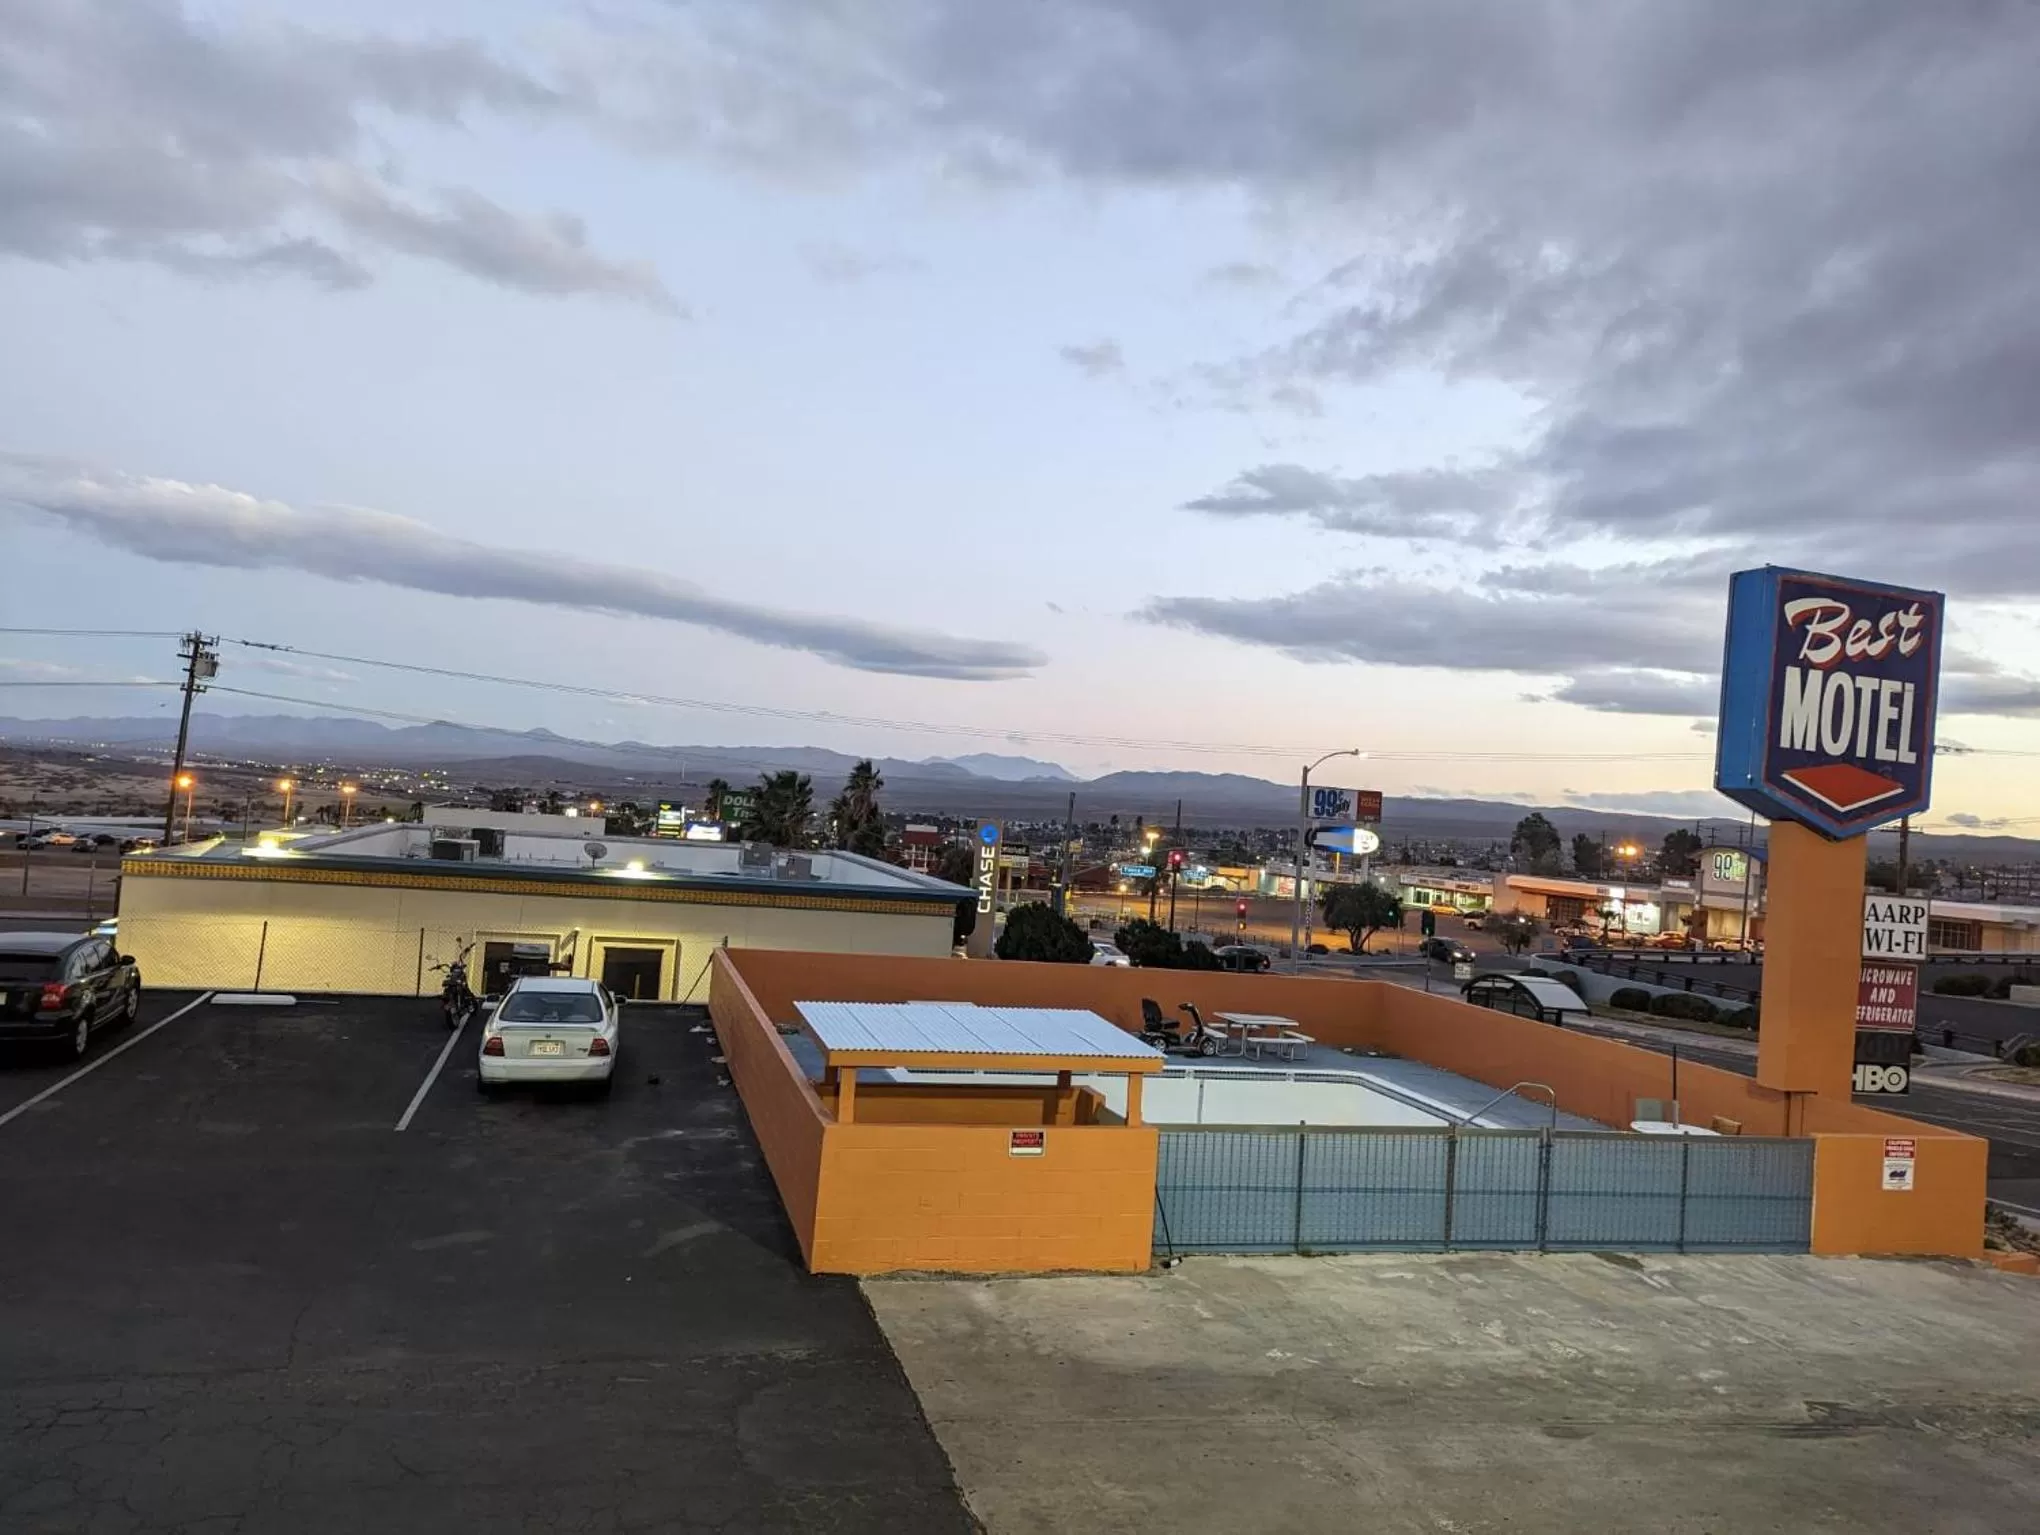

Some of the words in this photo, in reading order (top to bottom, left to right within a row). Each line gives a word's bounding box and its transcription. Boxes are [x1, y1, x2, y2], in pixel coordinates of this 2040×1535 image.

[1784, 597, 1926, 666] Best
[1779, 665, 1917, 765] MOTEL
[722, 795, 757, 808] DOLL
[977, 846, 995, 914] CHASE
[1865, 902, 1926, 925] AARP
[1864, 927, 1926, 954] WI-FI
[1860, 967, 1913, 986] ICROWAVE
[1869, 987, 1897, 1004] AND
[1856, 1005, 1914, 1025] EFRIGERATOR
